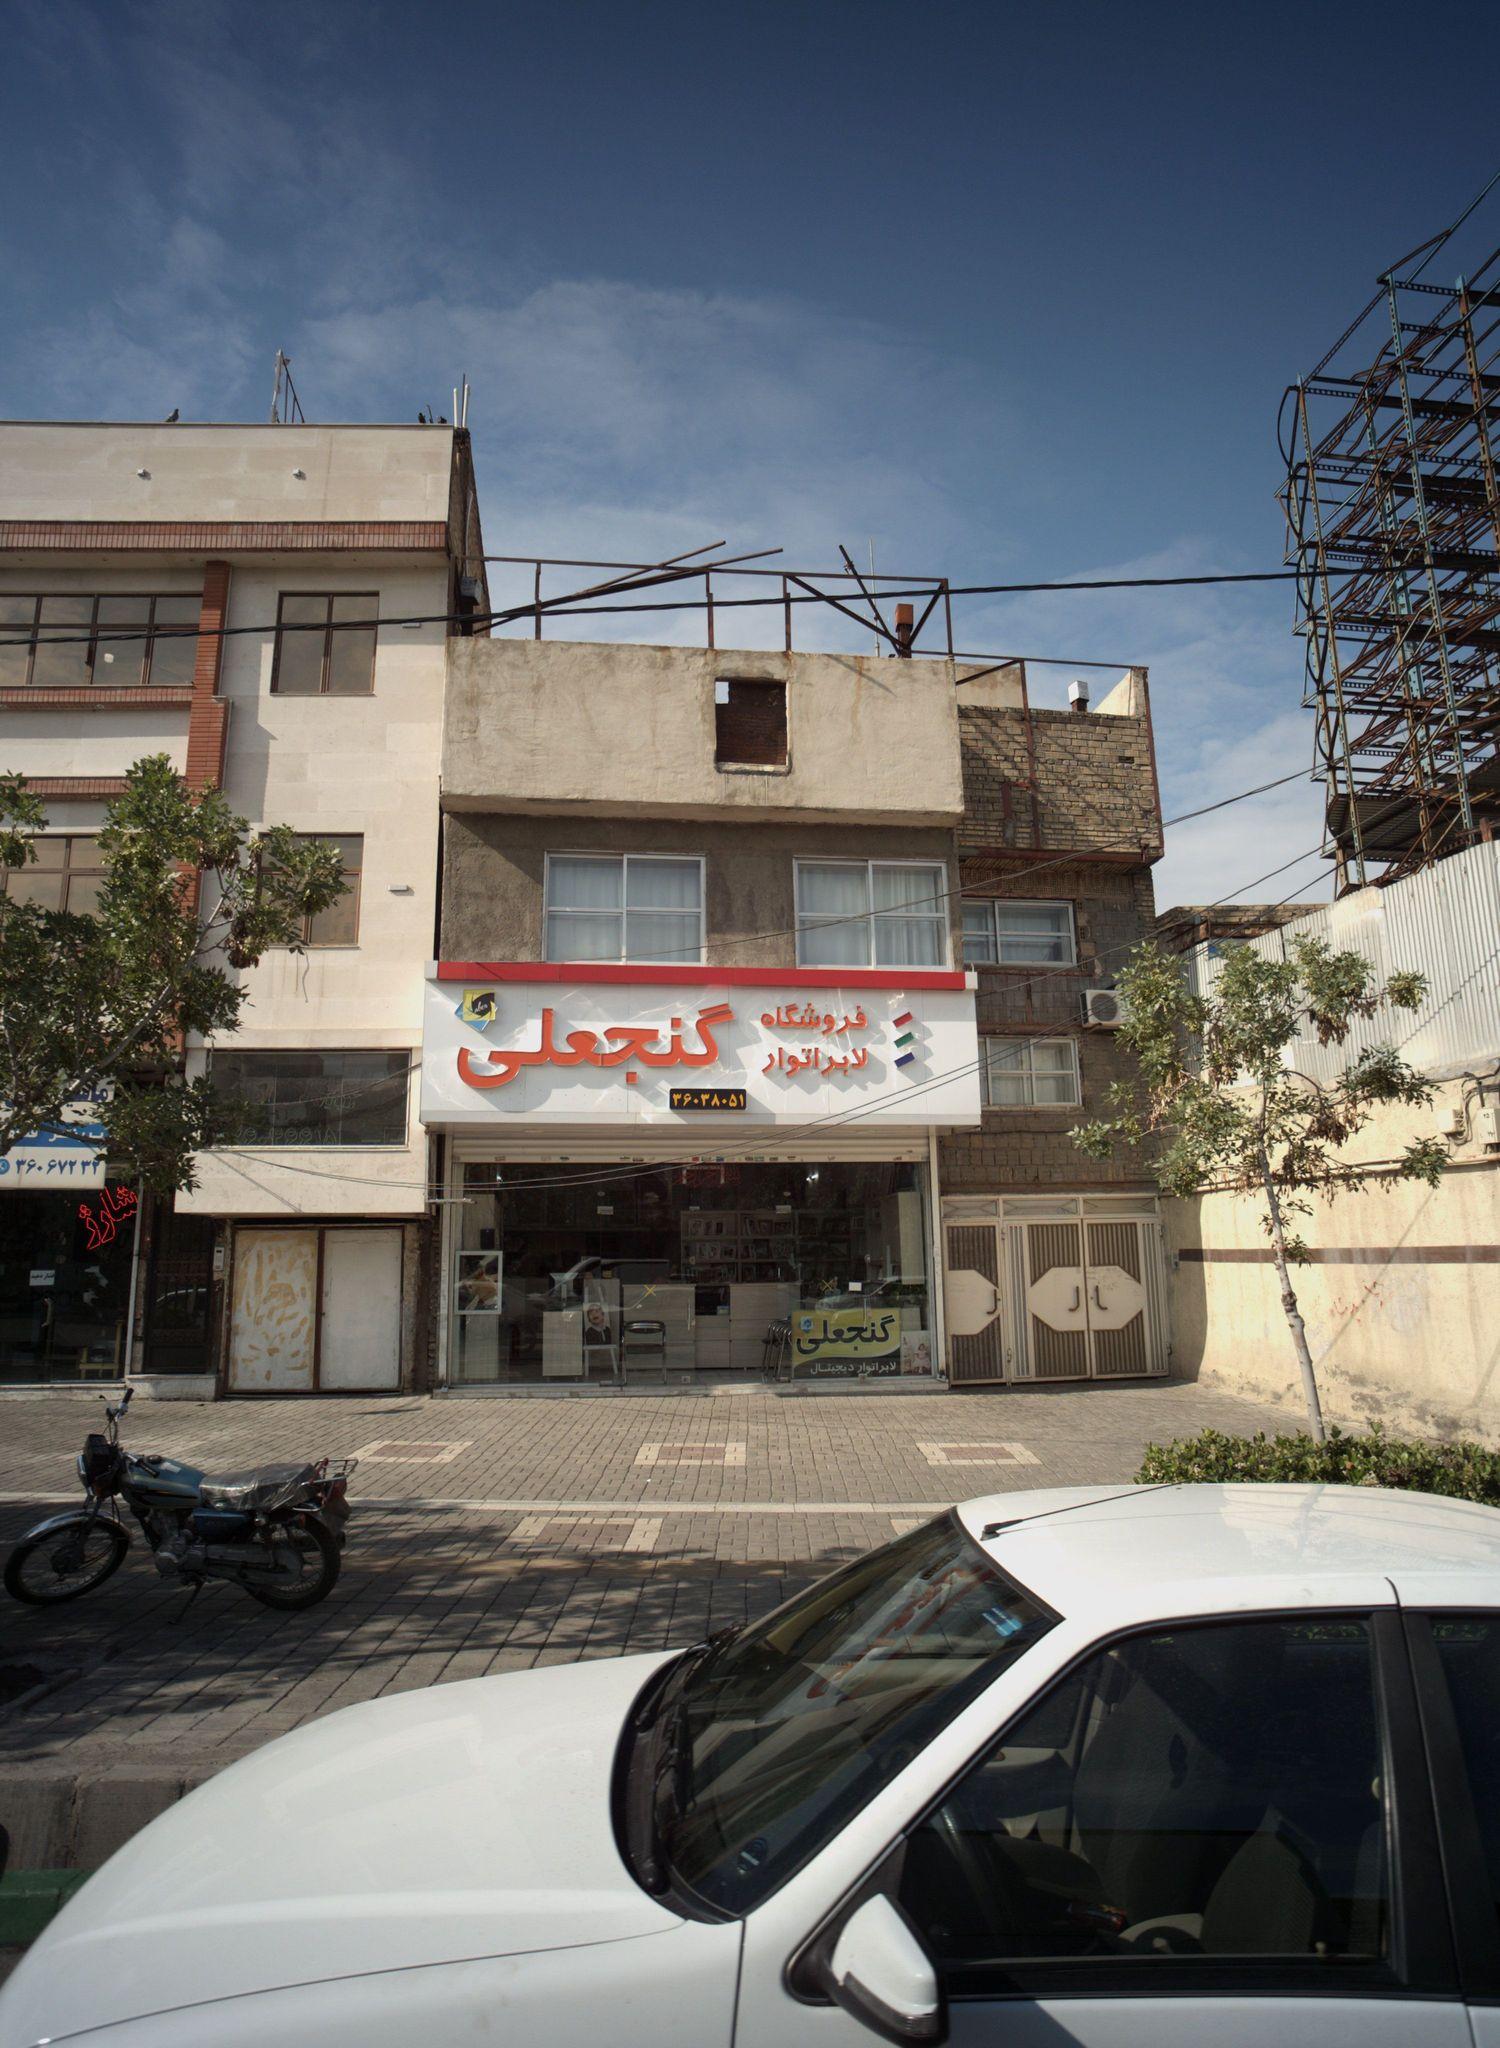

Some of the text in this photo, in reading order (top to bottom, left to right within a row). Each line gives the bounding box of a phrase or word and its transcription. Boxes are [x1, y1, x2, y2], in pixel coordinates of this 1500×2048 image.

[761, 1002, 868, 1036] فروشگاه
[457, 1002, 735, 1088] گنجعلی
[761, 1047, 869, 1079] لابراتوار
[672, 1093, 745, 1107] ۳۶۰۳۸۰۵۱
[796, 1314, 896, 1355] گنجعلی
[810, 1361, 897, 1376] لابراتوار دیجیتال
